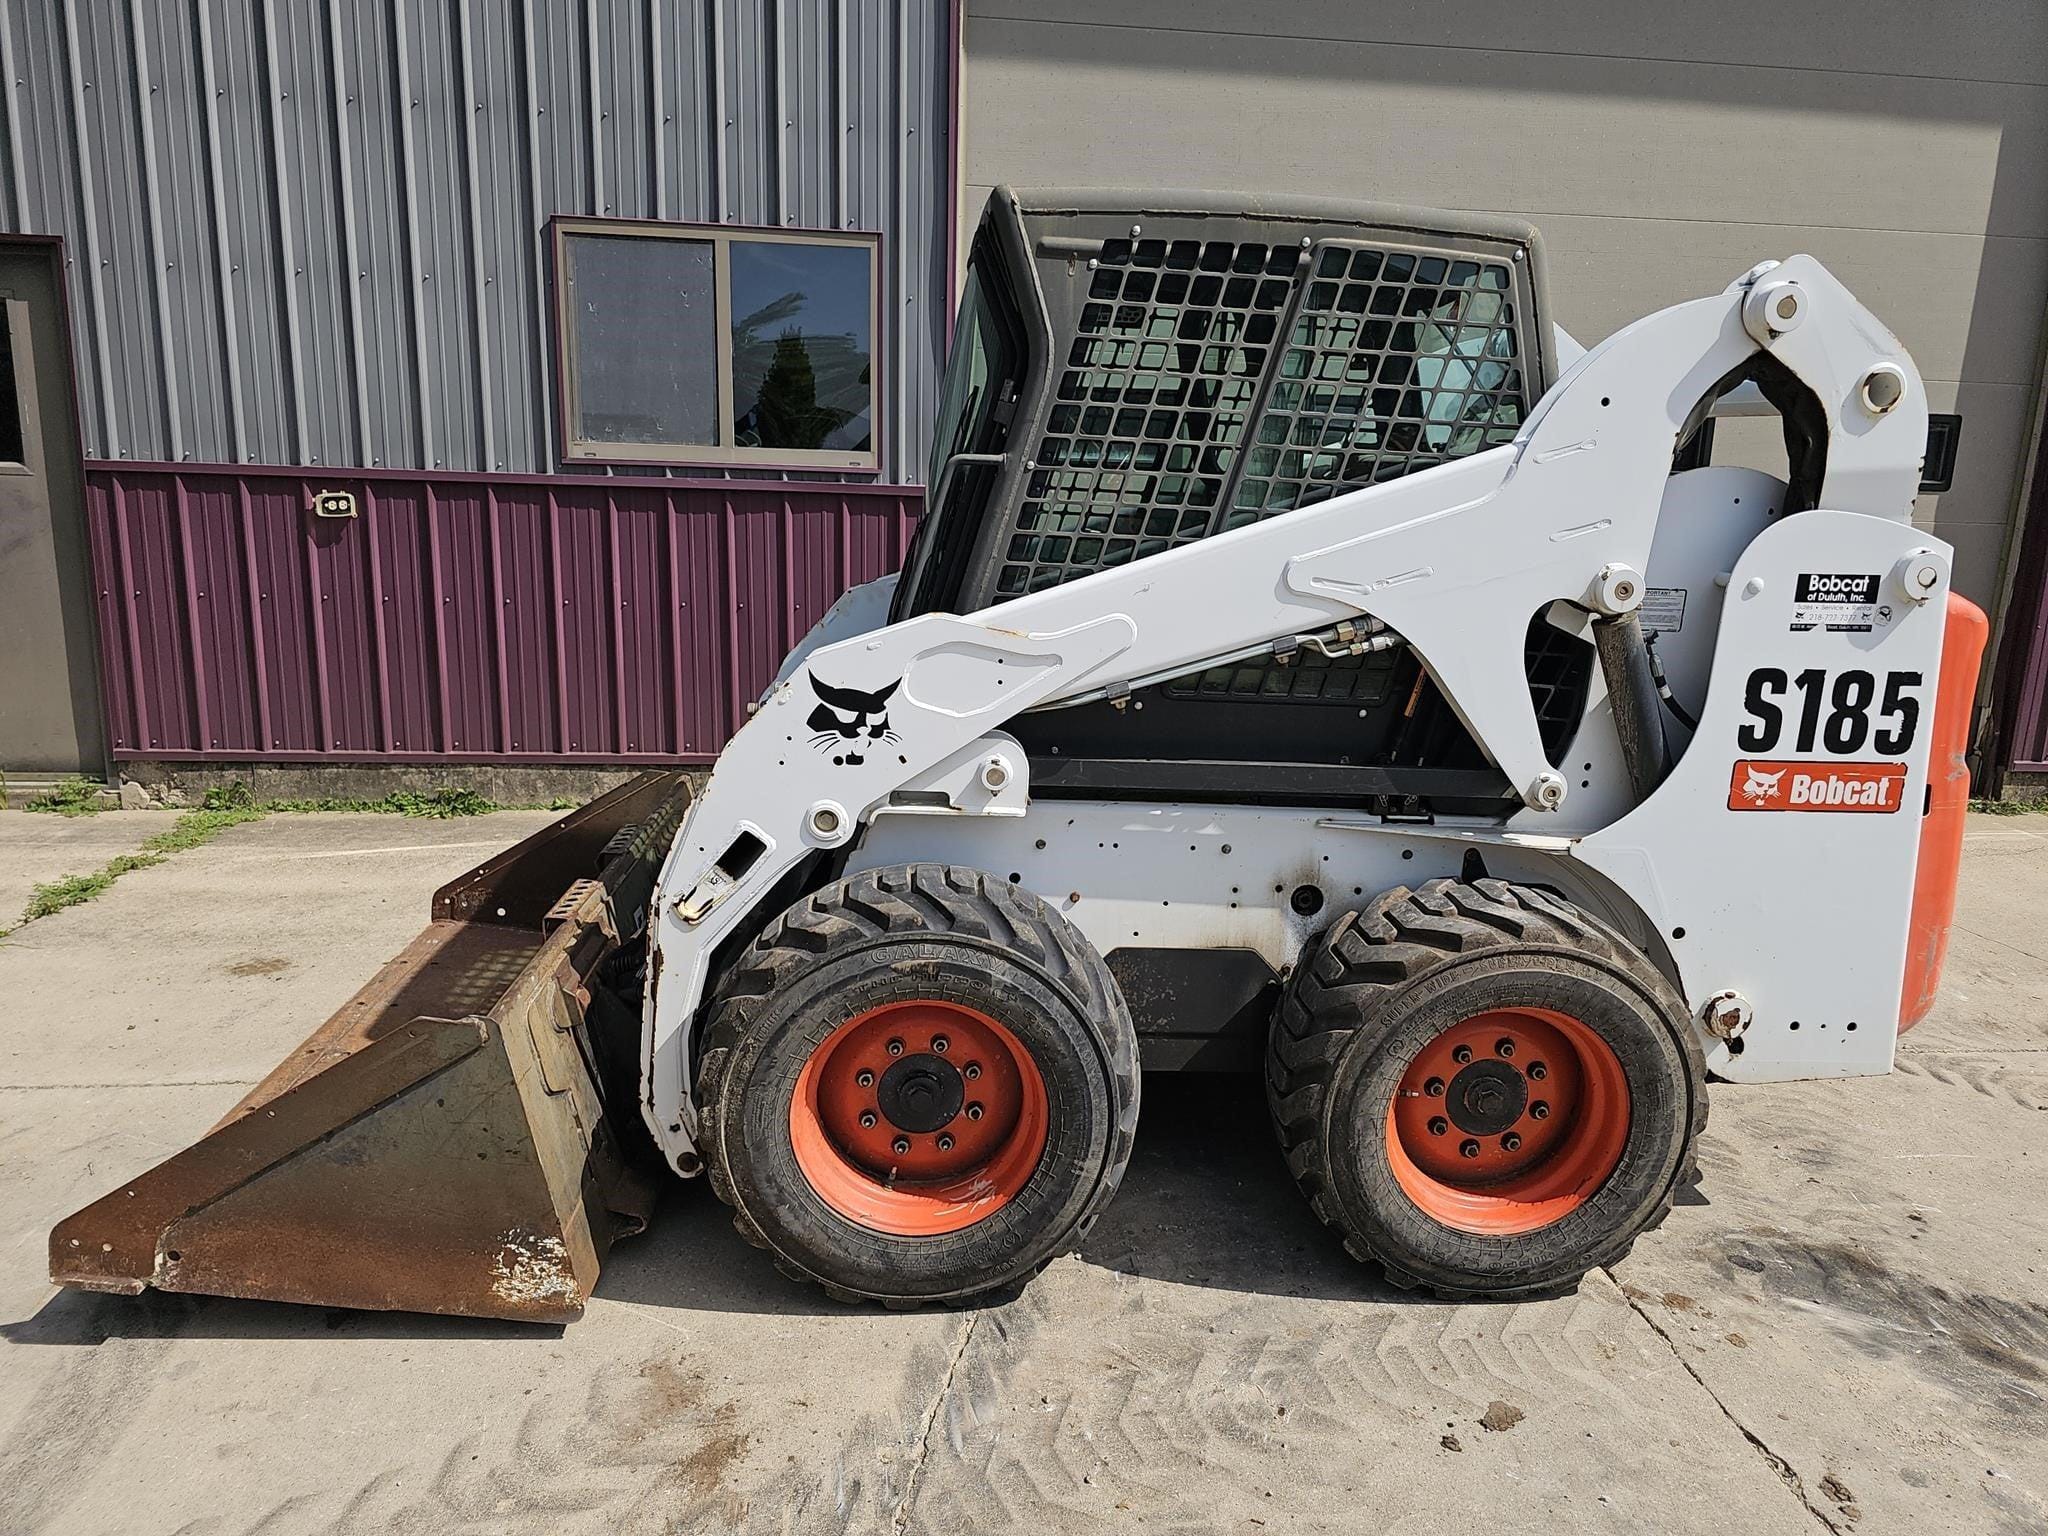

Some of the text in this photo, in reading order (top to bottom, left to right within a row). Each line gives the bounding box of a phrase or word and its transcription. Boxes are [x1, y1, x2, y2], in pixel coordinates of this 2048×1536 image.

[1807, 592, 1867, 602] of Duluth, Inc.
[1808, 575, 1869, 592] Bobcat
[1737, 667, 1923, 755] S185
[1789, 774, 1891, 806] Bobcat
[870, 943, 1007, 974] GALAXY
